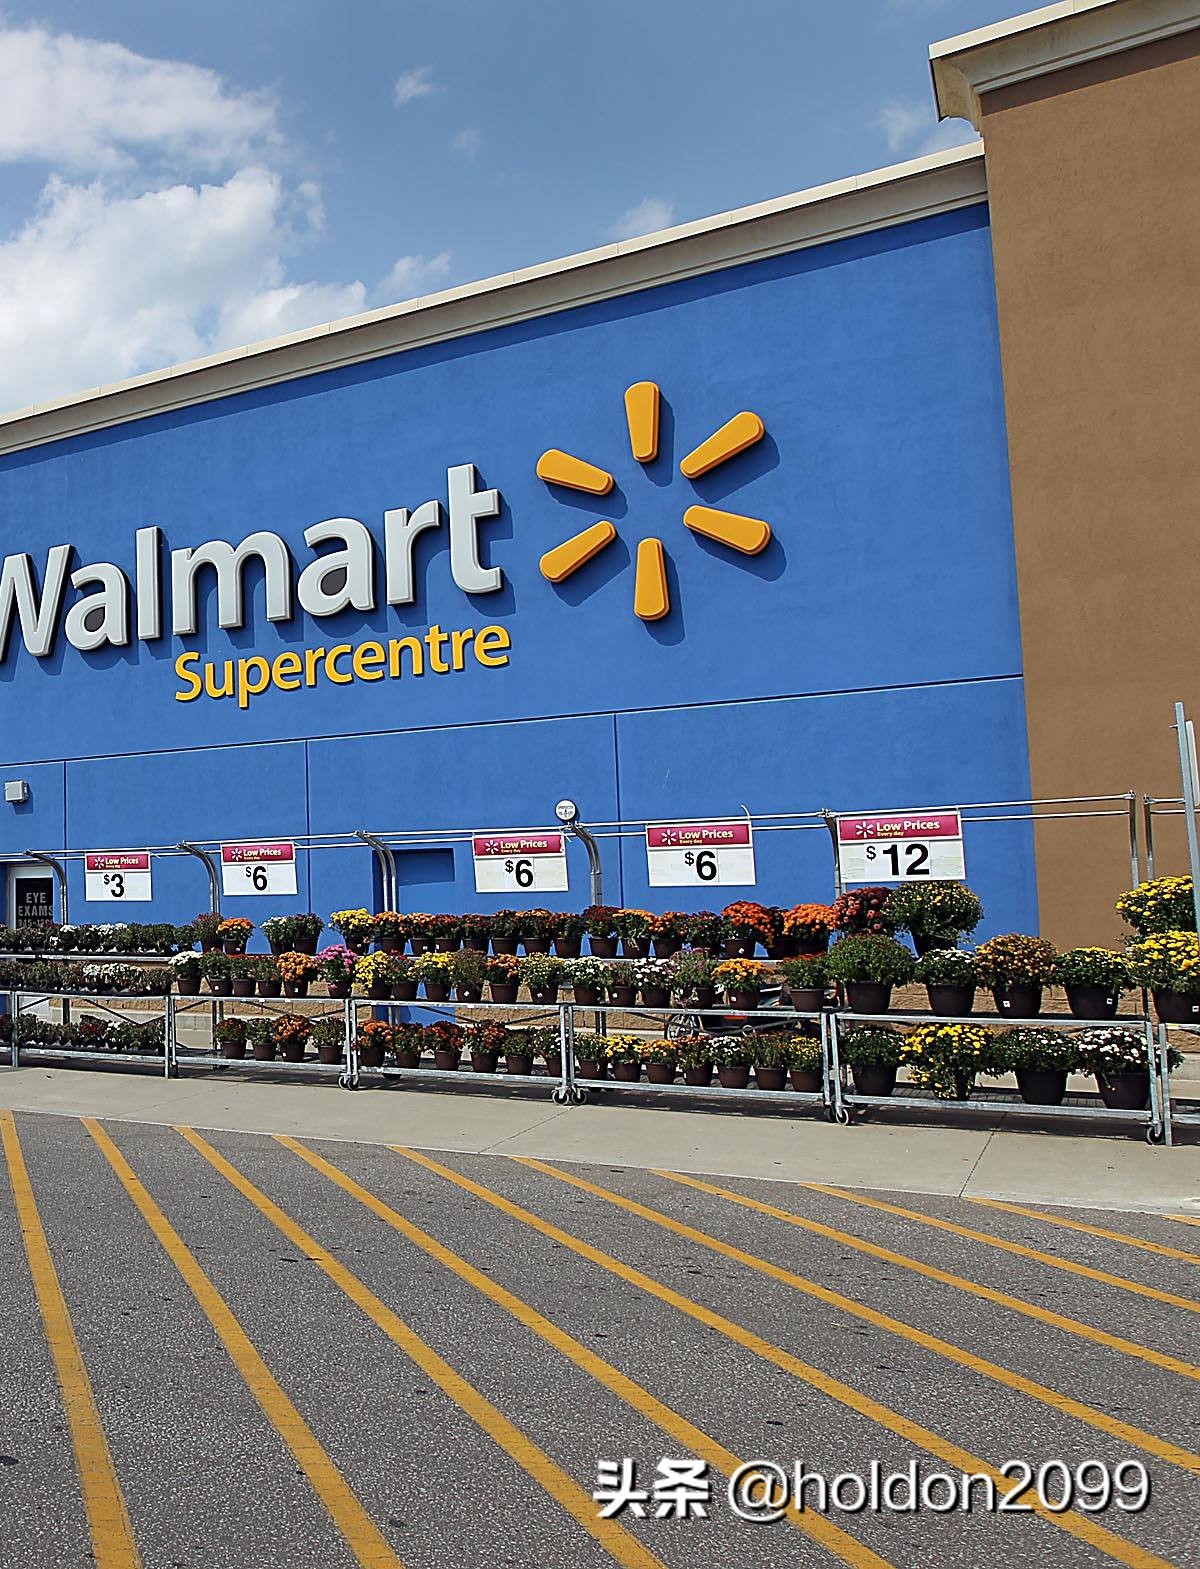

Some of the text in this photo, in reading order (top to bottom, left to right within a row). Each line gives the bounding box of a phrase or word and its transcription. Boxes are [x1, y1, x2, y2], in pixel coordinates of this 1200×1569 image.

[174, 624, 511, 708] Supercentre
[876, 820, 940, 832] Low Prices
[679, 829, 734, 840] Low Prices
[500, 839, 548, 849] Low Prices
[243, 847, 282, 857] Low Prices
[120, 856, 139, 865] Prices
[25, 892, 47, 904] EYE
[17, 905, 54, 917] EXAMS
